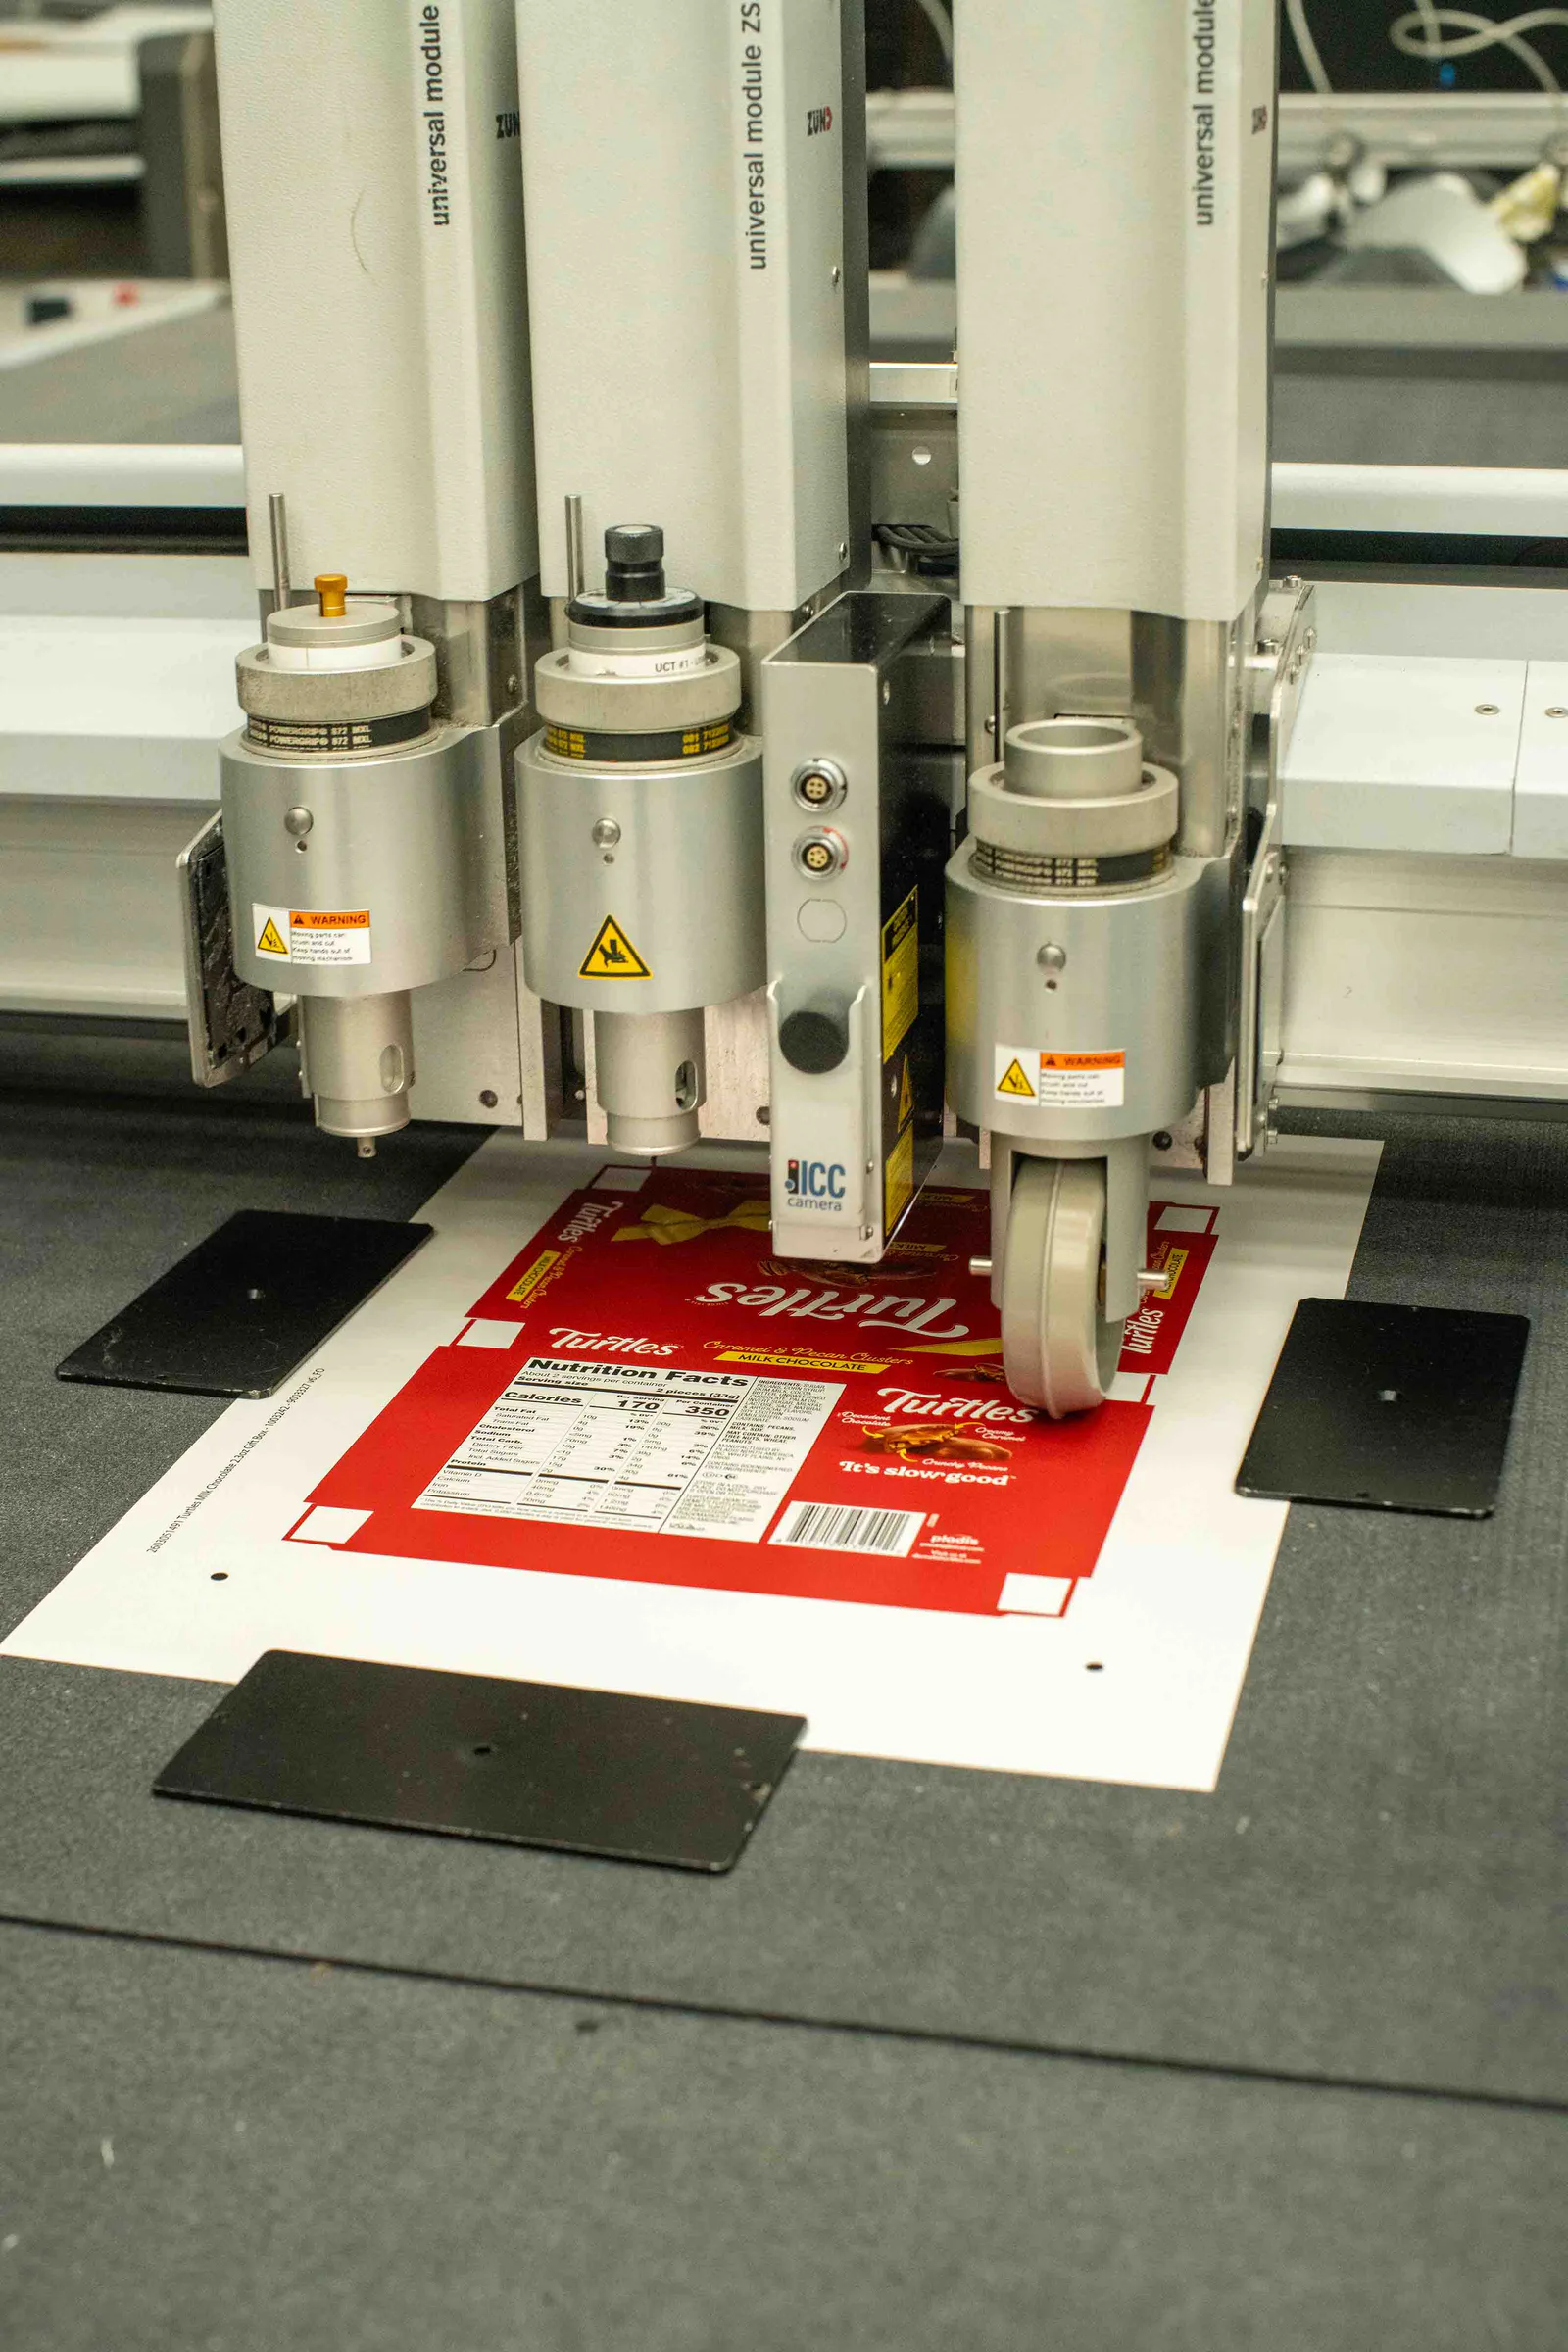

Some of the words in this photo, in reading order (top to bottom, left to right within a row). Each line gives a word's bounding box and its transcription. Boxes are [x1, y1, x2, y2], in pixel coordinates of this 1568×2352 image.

[741, 3, 760, 33] ZS
[419, 5, 443, 102] module
[742, 45, 763, 142] module
[423, 111, 450, 226] universal
[1193, 105, 1214, 225] universal
[743, 153, 766, 270] universal
[655, 662, 676, 672] UCT
[679, 660, 689, 670] #1
[353, 735, 372, 744] MXL
[311, 915, 366, 925] WARNING
[1064, 1055, 1121, 1066] WARNING
[787, 1197, 842, 1211] camera
[557, 1200, 624, 1243] Turtles
[695, 1282, 970, 1338] Turtles
[549, 1327, 679, 1356] Turtles
[704, 1341, 771, 1354] Caramel
[792, 1347, 846, 1360] Pecan
[850, 1352, 914, 1365] Clusters
[528, 1359, 657, 1379] Nutrition
[665, 1371, 749, 1387] Facts
[737, 1354, 773, 1363] MILK
[776, 1357, 867, 1371] CHOCOLATE
[505, 1392, 582, 1403] Calories
[618, 1400, 660, 1410] 170
[685, 1406, 730, 1416] 350
[877, 1387, 1040, 1423] Turtles
[176, 1501, 202, 1519] Turtles
[207, 1463, 237, 1489] Chocolate
[252, 1430, 269, 1440] Box
[839, 1461, 880, 1474] It's
[884, 1466, 946, 1481] slow
[944, 1471, 1011, 1487] good
[930, 1535, 979, 1545] pladis
